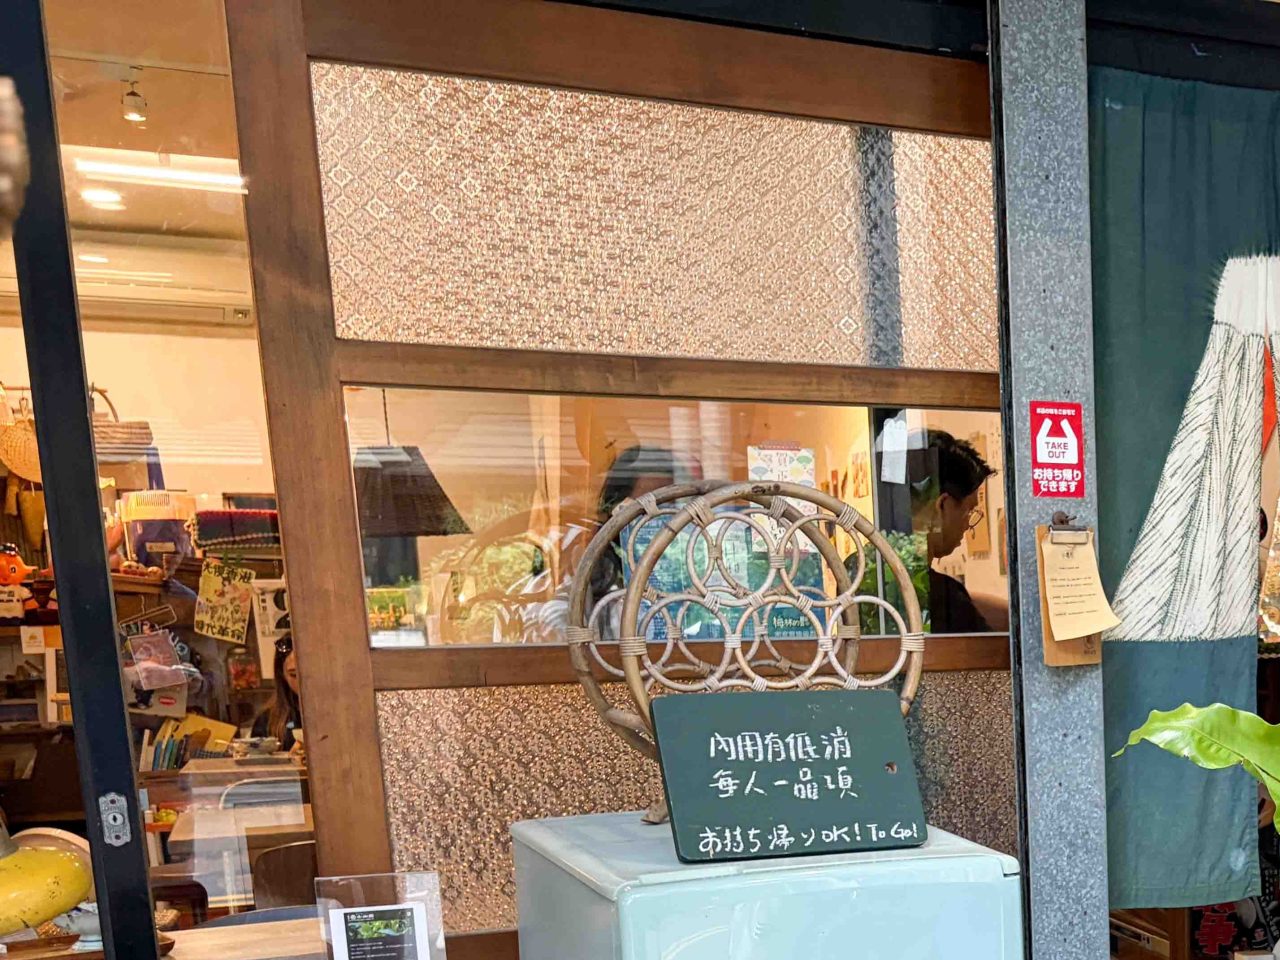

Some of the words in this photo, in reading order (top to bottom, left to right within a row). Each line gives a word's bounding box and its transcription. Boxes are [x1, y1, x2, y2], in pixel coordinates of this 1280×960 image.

[1044, 441, 1069, 450] TAKE
[1047, 450, 1067, 459] OUT
[1033, 468, 1082, 481] お持ち帰り
[1038, 480, 1078, 493] できます
